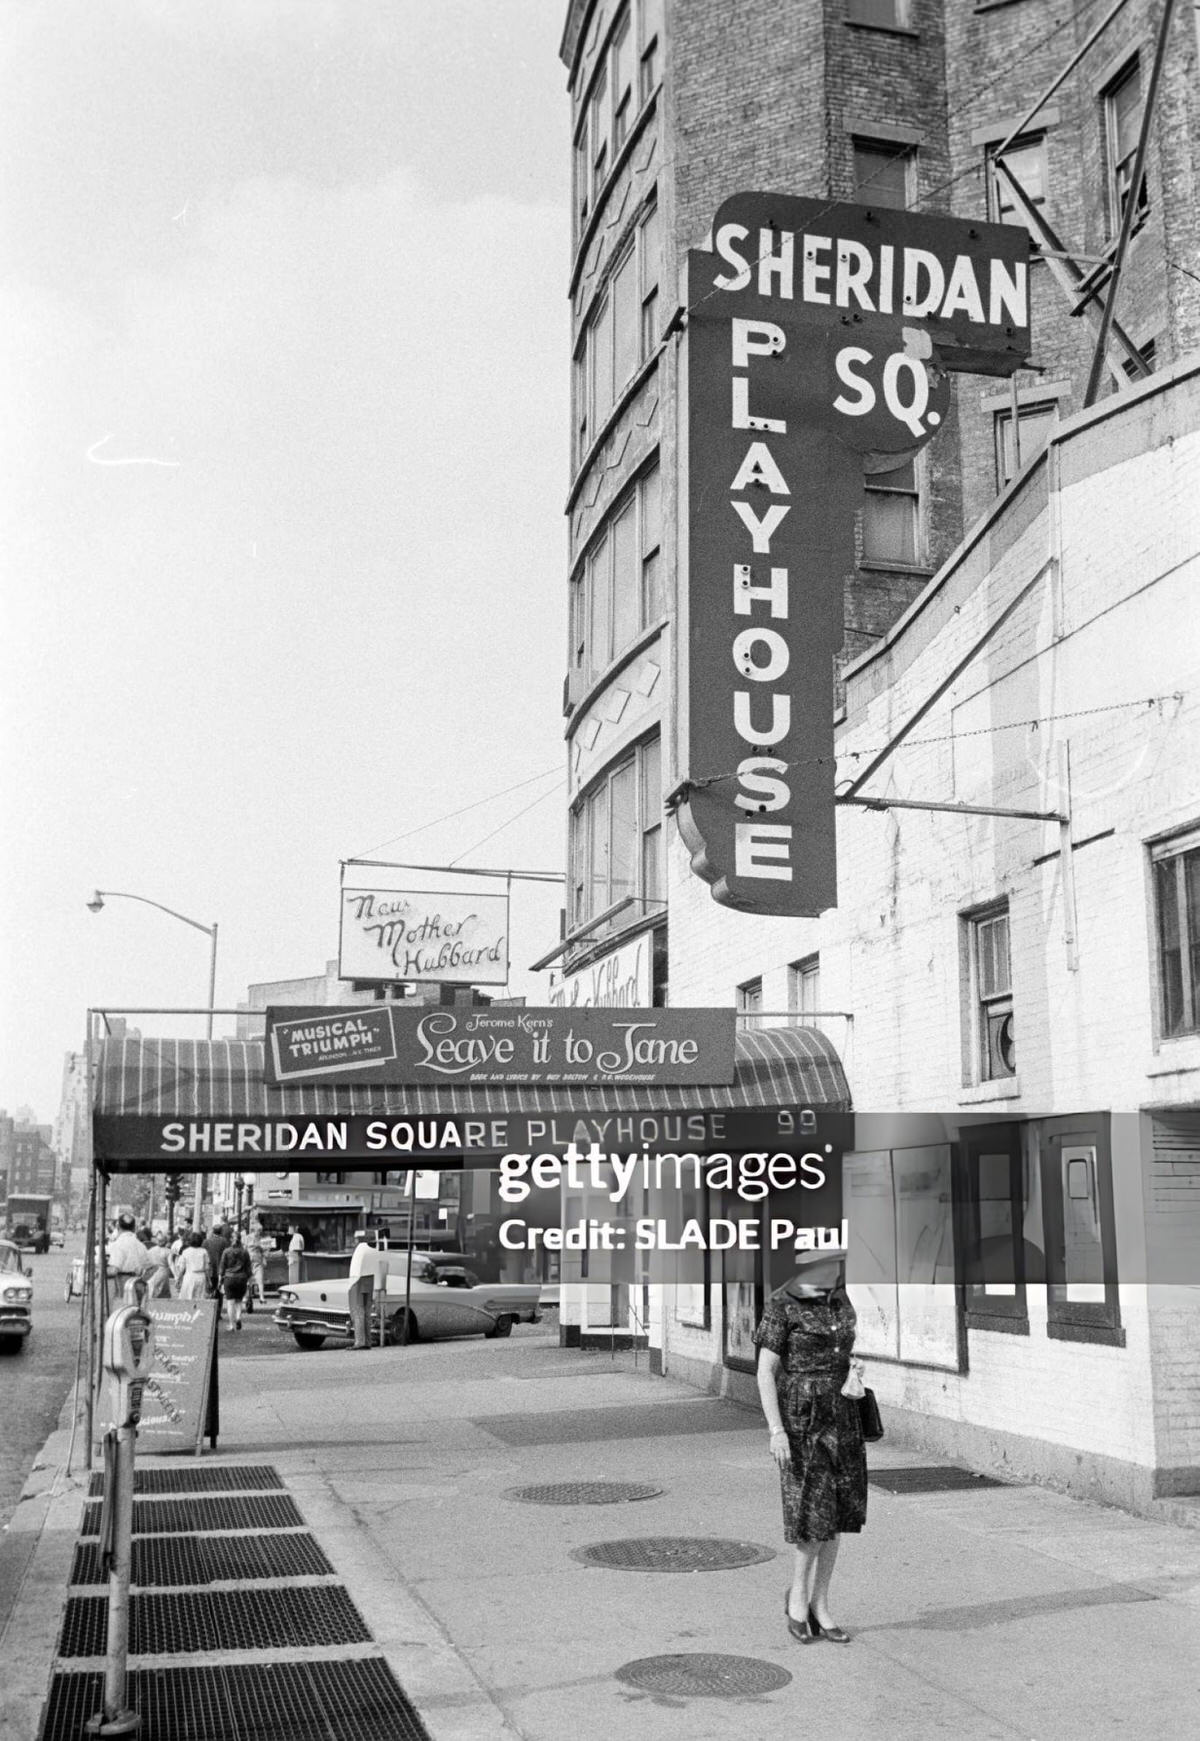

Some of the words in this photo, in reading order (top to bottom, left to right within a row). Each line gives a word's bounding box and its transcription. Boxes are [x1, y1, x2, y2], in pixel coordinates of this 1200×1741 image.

[712, 223, 1028, 328] SHERIDAN
[832, 346, 941, 438] SQ.
[730, 317, 793, 882] PLAYHOUSE
[346, 895, 410, 919] New
[363, 914, 477, 967] Mother
[402, 936, 504, 976] Hubbard
[414, 1012, 514, 1074] Leave
[532, 1028, 552, 1063] it
[563, 1028, 594, 1064] to
[596, 1022, 700, 1074] Jane
[466, 1013, 515, 1032] Jerome
[517, 1013, 554, 1033] Kern's
[160, 1122, 346, 1152] SHERIDAN
[365, 1121, 509, 1151] SQUARE
[527, 1115, 726, 1146] PLAYHOUSE
